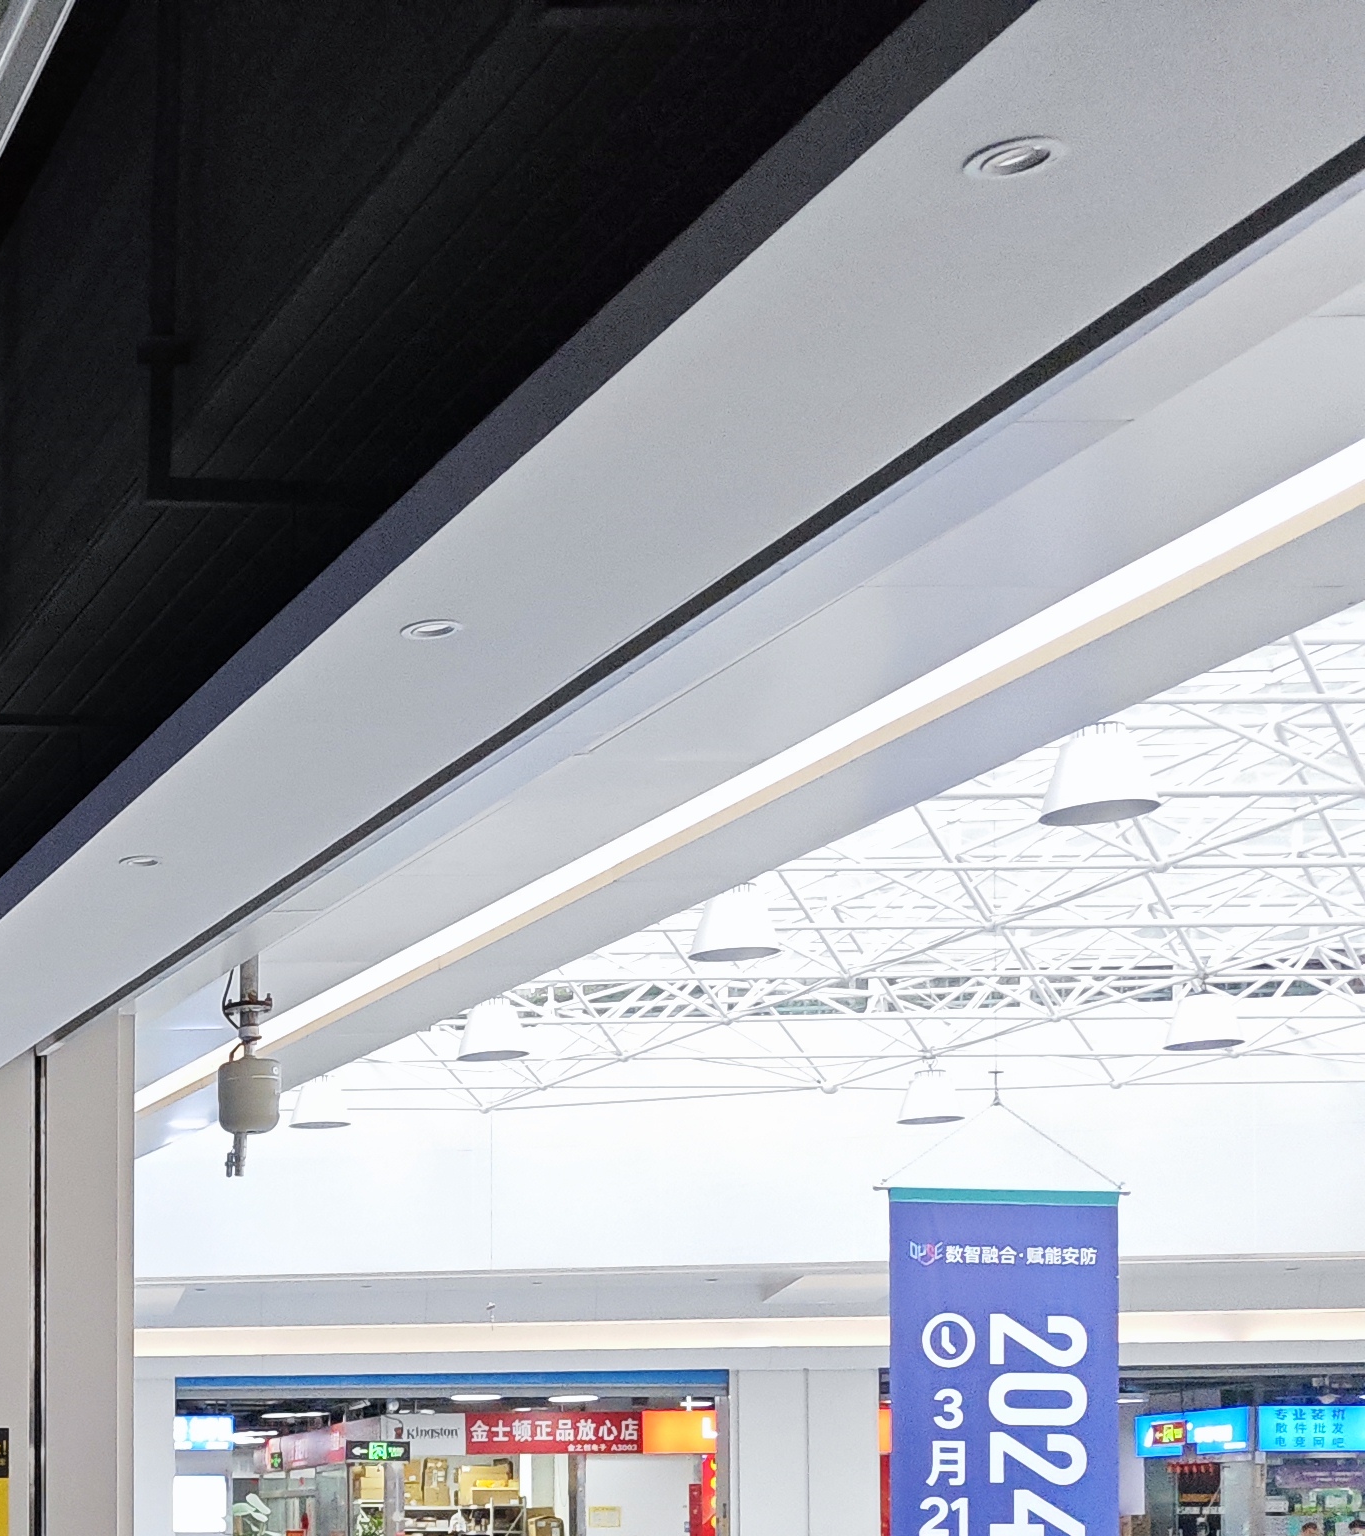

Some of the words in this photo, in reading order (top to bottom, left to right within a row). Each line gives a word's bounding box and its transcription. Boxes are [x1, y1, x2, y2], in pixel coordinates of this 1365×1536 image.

[945, 1245, 1098, 1266] 数智融合·赋能安防
[1274, 1408, 1346, 1420] 专业装机
[407, 1427, 460, 1440] Kingston
[469, 1418, 639, 1443] 金士顿正品放心店
